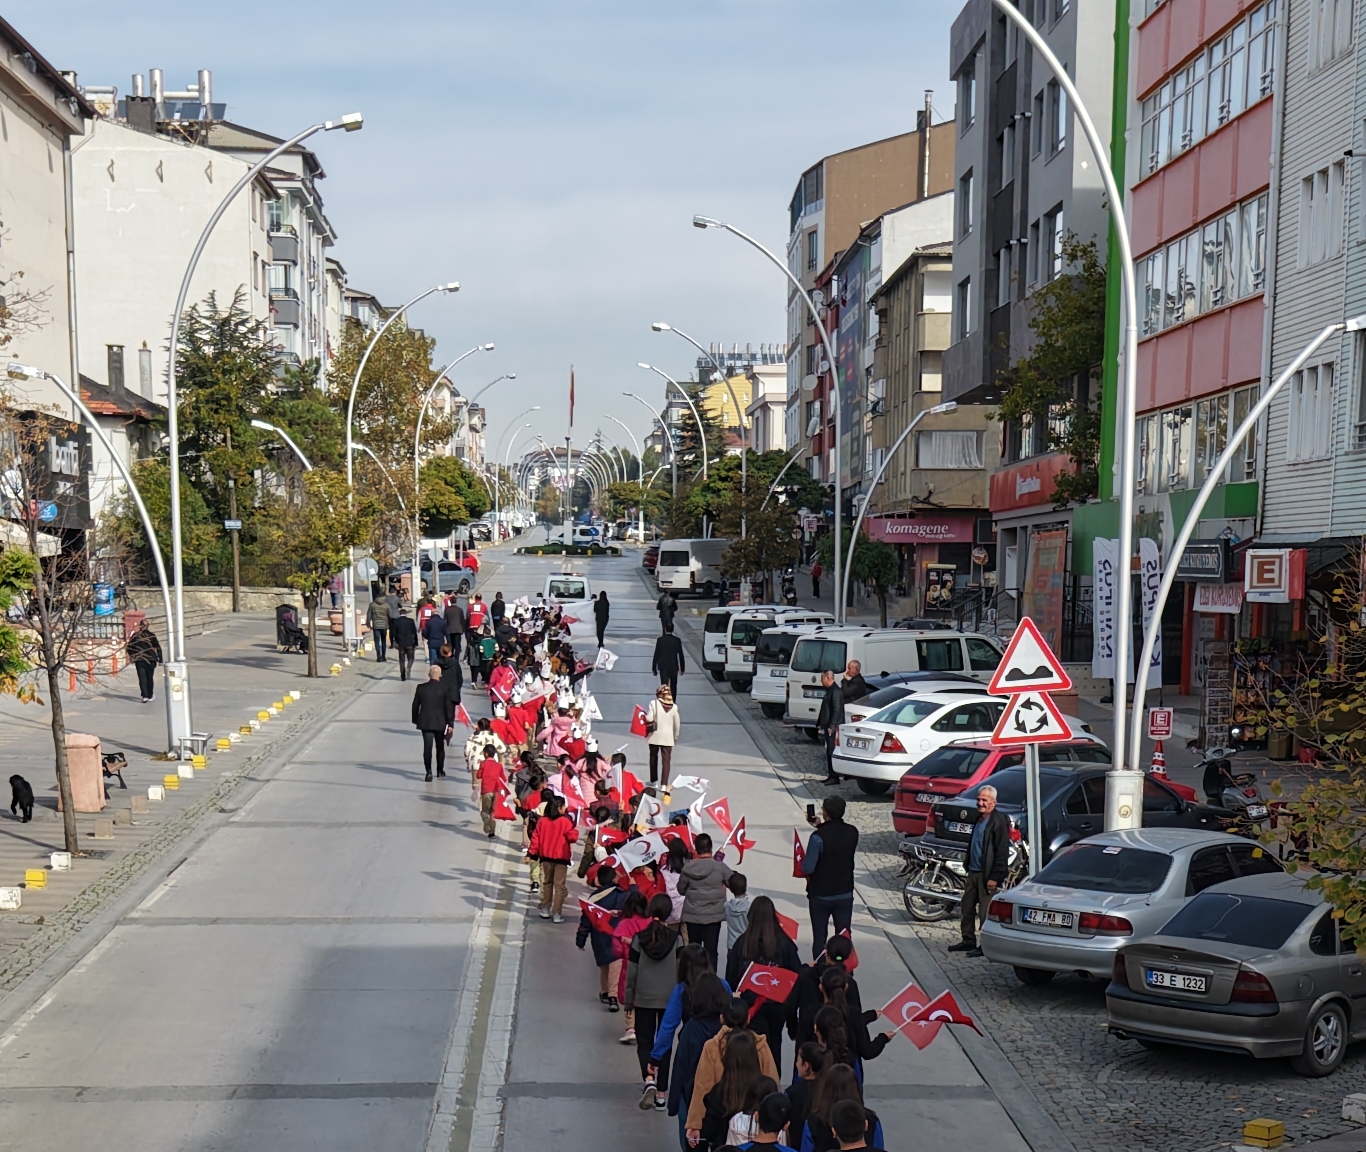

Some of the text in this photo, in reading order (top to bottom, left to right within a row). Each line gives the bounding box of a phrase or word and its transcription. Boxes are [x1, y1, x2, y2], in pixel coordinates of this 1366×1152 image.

[885, 521, 949, 538] komagene
[1029, 910, 1038, 921] 42
[1042, 912, 1056, 923] FMA
[1061, 914, 1071, 925] 80
[1153, 972, 1204, 990] 33 E 1232
